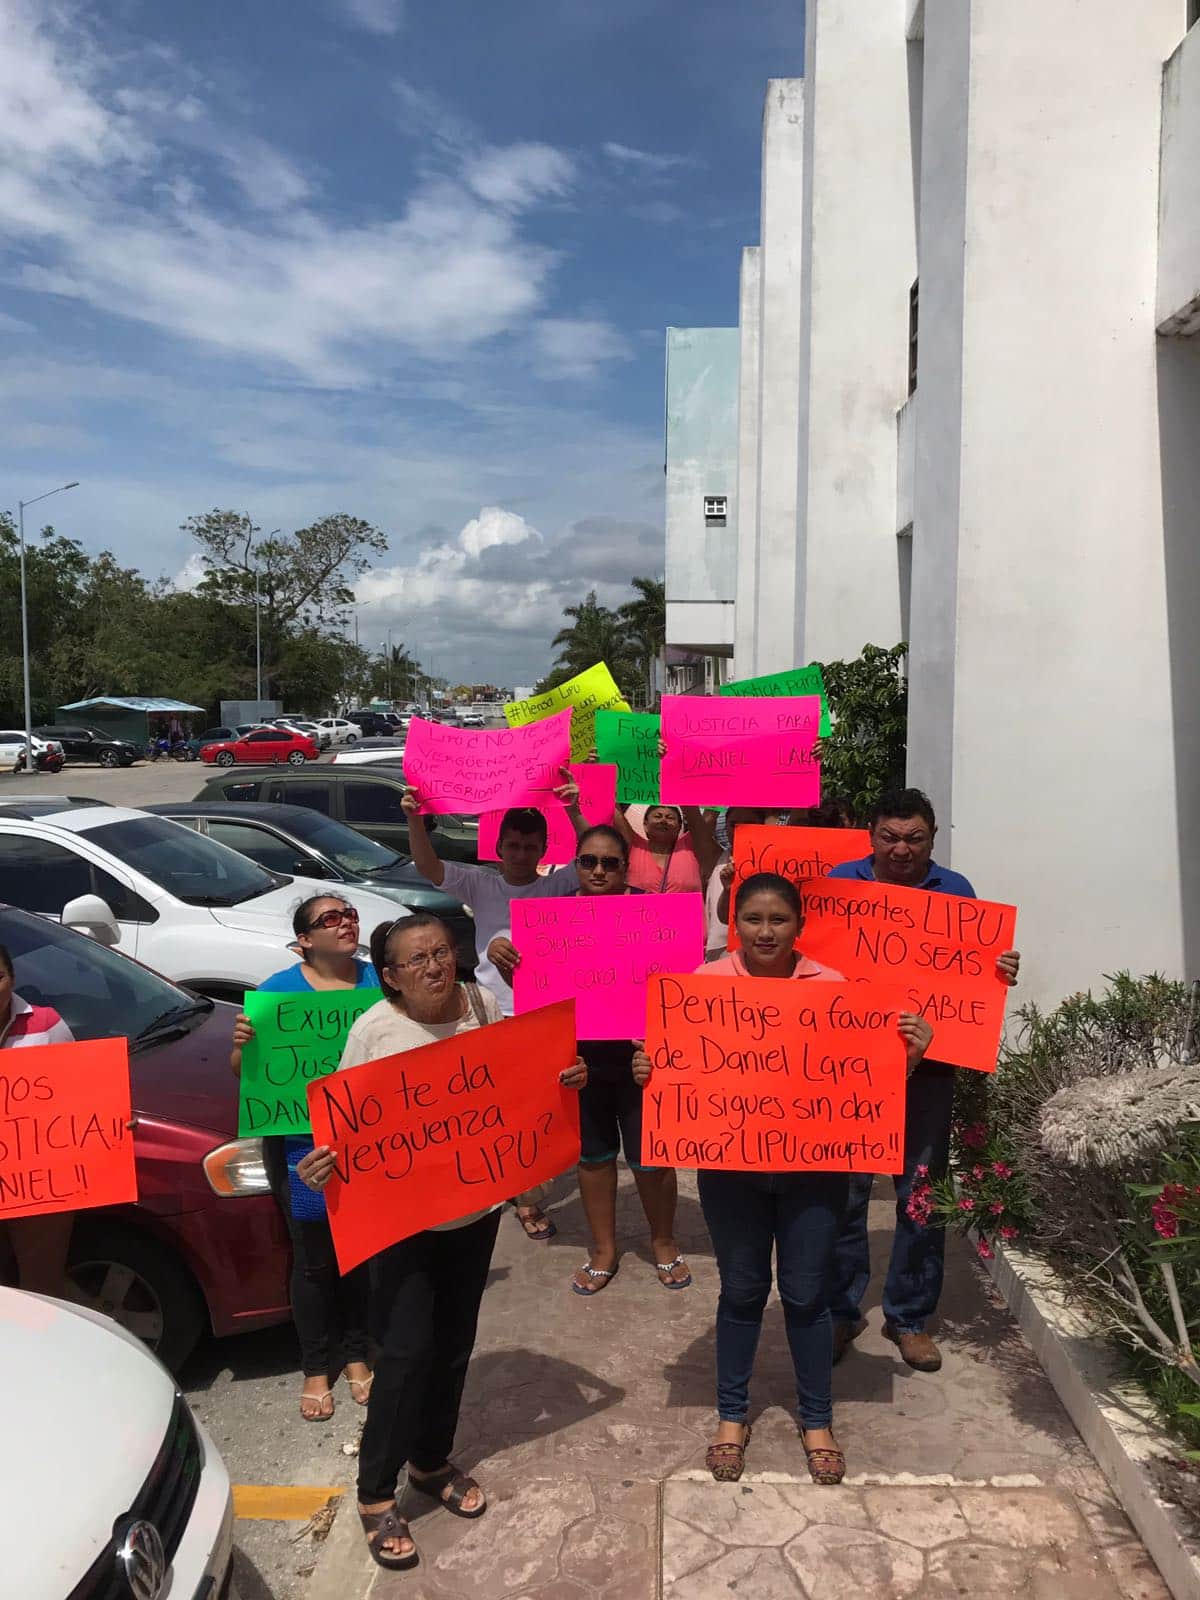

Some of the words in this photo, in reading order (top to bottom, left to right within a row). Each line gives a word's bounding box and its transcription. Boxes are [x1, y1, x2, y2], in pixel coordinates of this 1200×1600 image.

[673, 712, 761, 734] JUSTICIA
[776, 713, 812, 729] PARA
[682, 743, 752, 772] DANIEL
[795, 877, 915, 930] Transportes
[924, 895, 1004, 947] LIPU
[855, 927, 908, 965] NO
[914, 942, 983, 977] SEAS
[658, 977, 782, 1040] Peritaje
[799, 1008, 818, 1032] a
[826, 995, 897, 1030] favor
[653, 1037, 690, 1071] de
[699, 1034, 790, 1077] Daniel
[804, 1042, 873, 1088] Lara
[322, 1079, 383, 1142] No
[393, 1071, 438, 1110] te
[448, 1055, 495, 1096] da
[669, 1081, 699, 1123] Tú
[707, 1087, 786, 1130] sigues
[791, 1094, 832, 1123] sin
[840, 1091, 887, 1123] dar
[456, 1112, 553, 1185] LIPU?
[649, 1130, 669, 1162] la
[675, 1131, 735, 1164] cara?
[741, 1130, 797, 1165] LIPU
